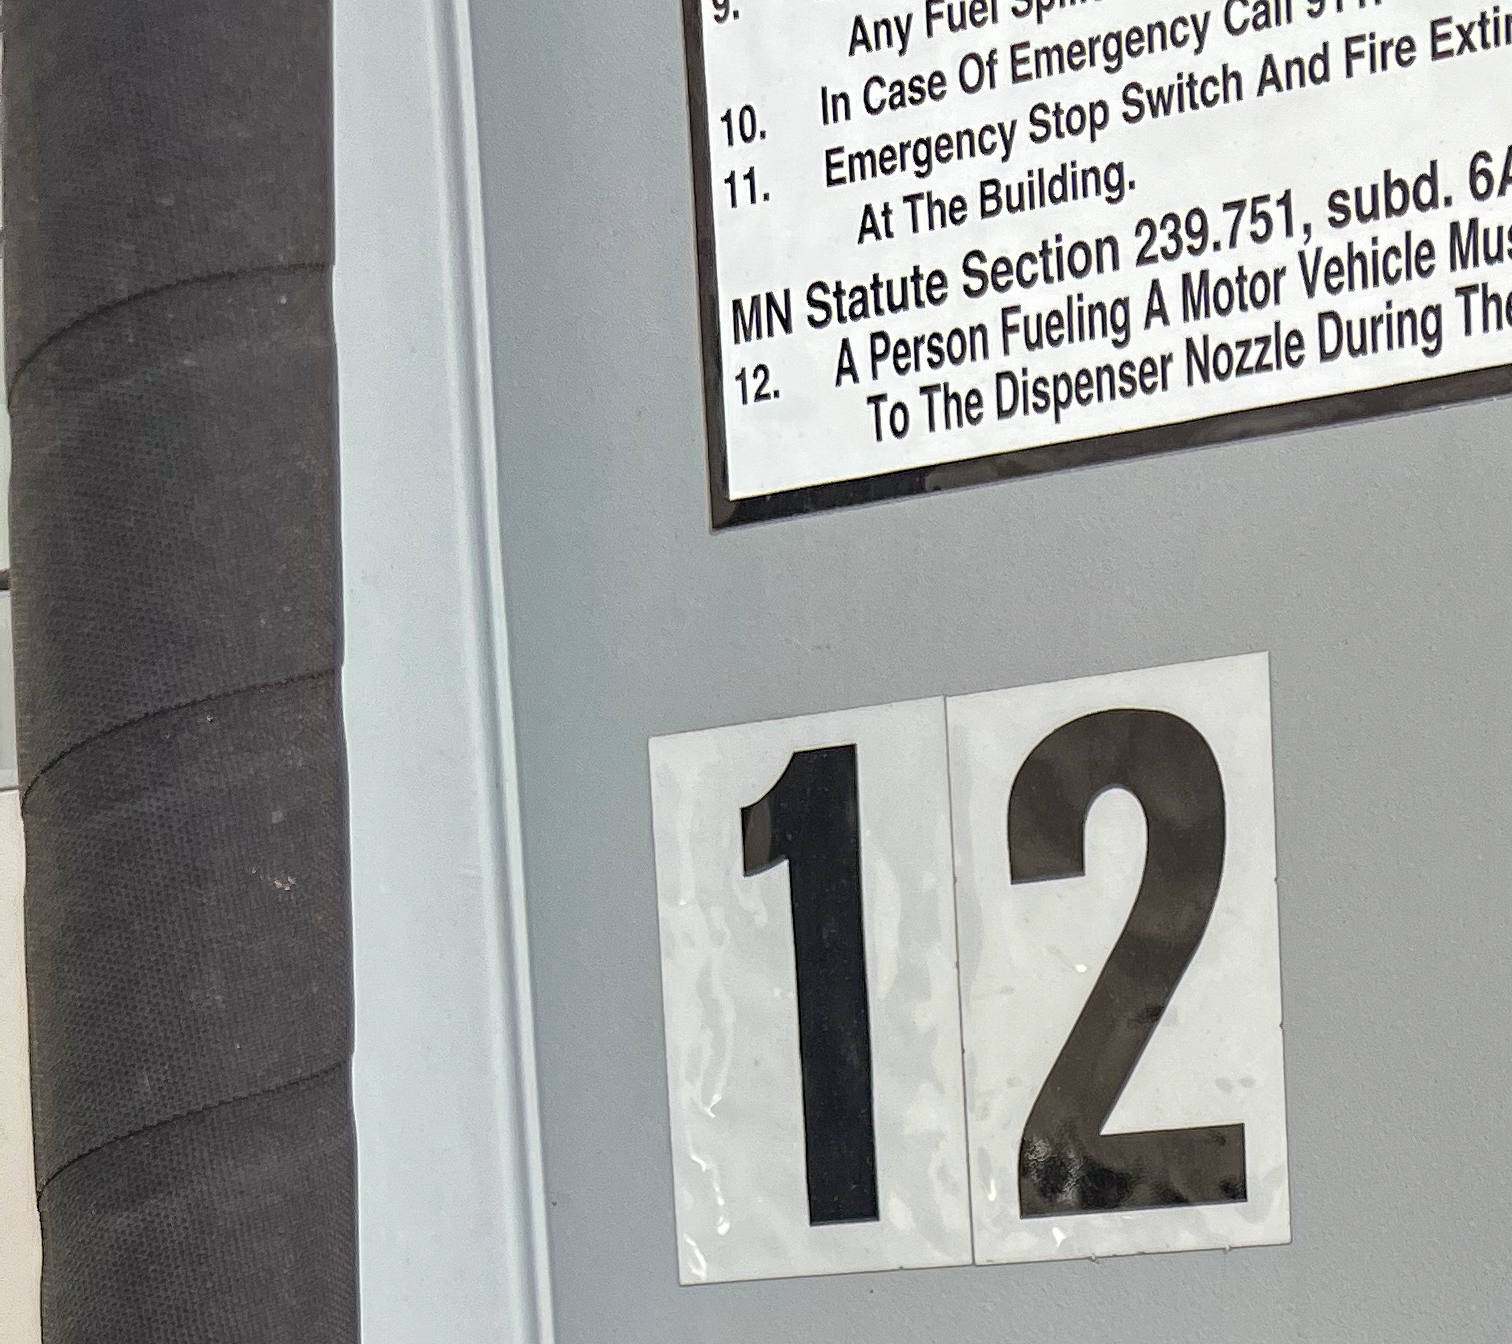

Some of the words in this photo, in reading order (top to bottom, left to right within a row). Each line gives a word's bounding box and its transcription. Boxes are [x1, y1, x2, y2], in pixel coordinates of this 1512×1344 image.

[720, 105, 767, 147] 10.
[822, 87, 850, 125] In
[864, 71, 946, 115] Case
[959, 49, 997, 93] Of
[1011, 13, 1206, 84] Emergency
[725, 167, 769, 208] 11.
[825, 117, 1016, 187] Emergency
[1029, 99, 1110, 144] Stop
[1122, 63, 1243, 124] Switch
[1256, 42, 1331, 97] And
[1345, 33, 1416, 79] Fire
[732, 288, 792, 344] MN
[807, 266, 948, 328] Statute
[963, 234, 1119, 298] Section
[1135, 189, 1311, 266] 239.751,
[1328, 160, 1452, 227] subd.
[736, 364, 779, 404] 12.
[836, 338, 859, 386] A
[870, 324, 988, 380] Person
[1002, 293, 1130, 355] Fueling
[1144, 279, 1169, 329] A
[1182, 266, 1286, 322] Motor
[1298, 231, 1435, 298] Vehicle
[740, 707, 1248, 1226] 12
